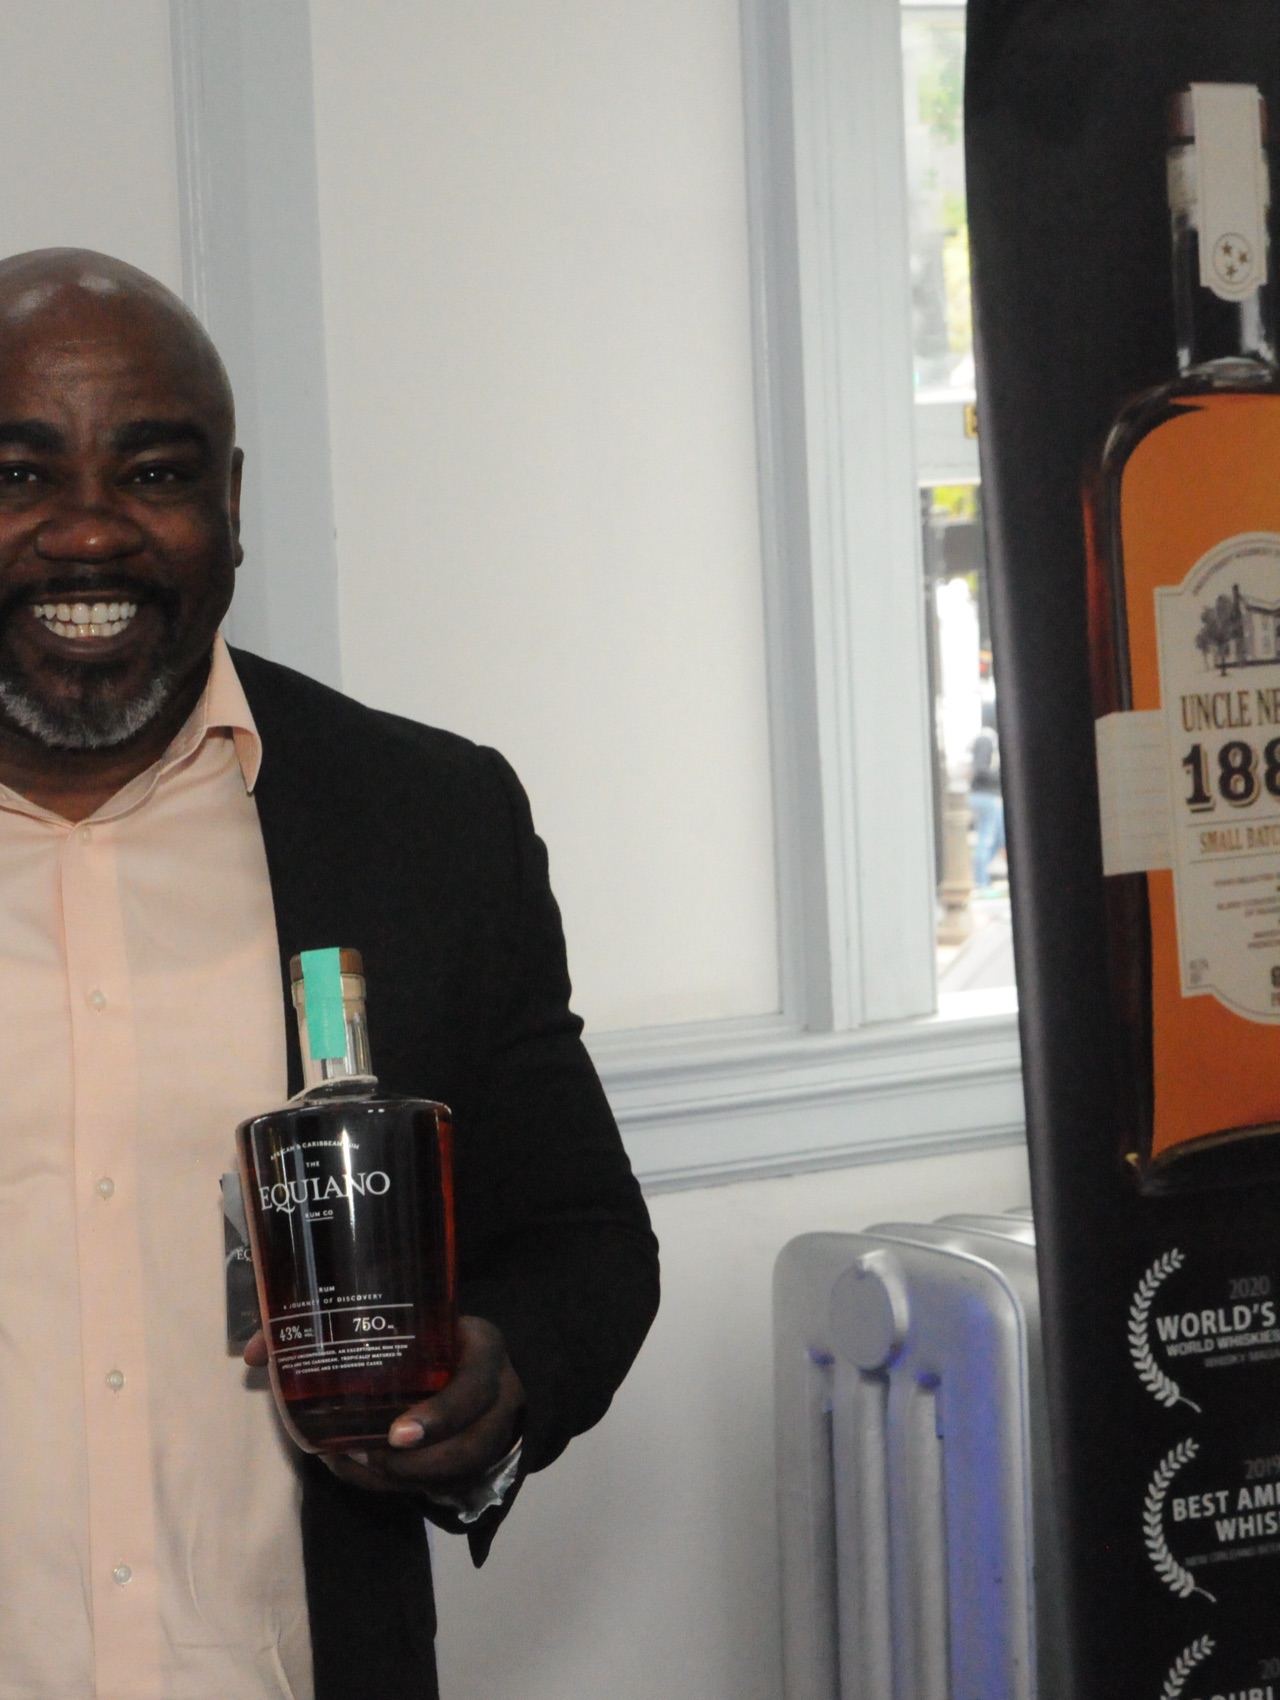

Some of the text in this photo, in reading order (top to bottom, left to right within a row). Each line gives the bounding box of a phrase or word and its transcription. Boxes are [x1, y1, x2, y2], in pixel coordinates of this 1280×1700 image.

[1181, 691, 1251, 732] UNCLE
[1200, 828, 1243, 854] SMALL
[306, 1160, 320, 1168] THE
[259, 1171, 391, 1214] EQUIANO
[305, 1209, 334, 1219] RUM CO
[337, 1293, 382, 1303] DISCOVERY
[1228, 1276, 1271, 1300] 2020
[280, 1325, 302, 1341] 43%
[353, 1315, 386, 1332] 750
[1156, 1301, 1276, 1341] WORLD'S
[1166, 1338, 1215, 1357] WORLD
[1172, 1490, 1229, 1522] BEST
[1214, 1511, 1280, 1542] WHIS
[1259, 1656, 1280, 1680] 20
